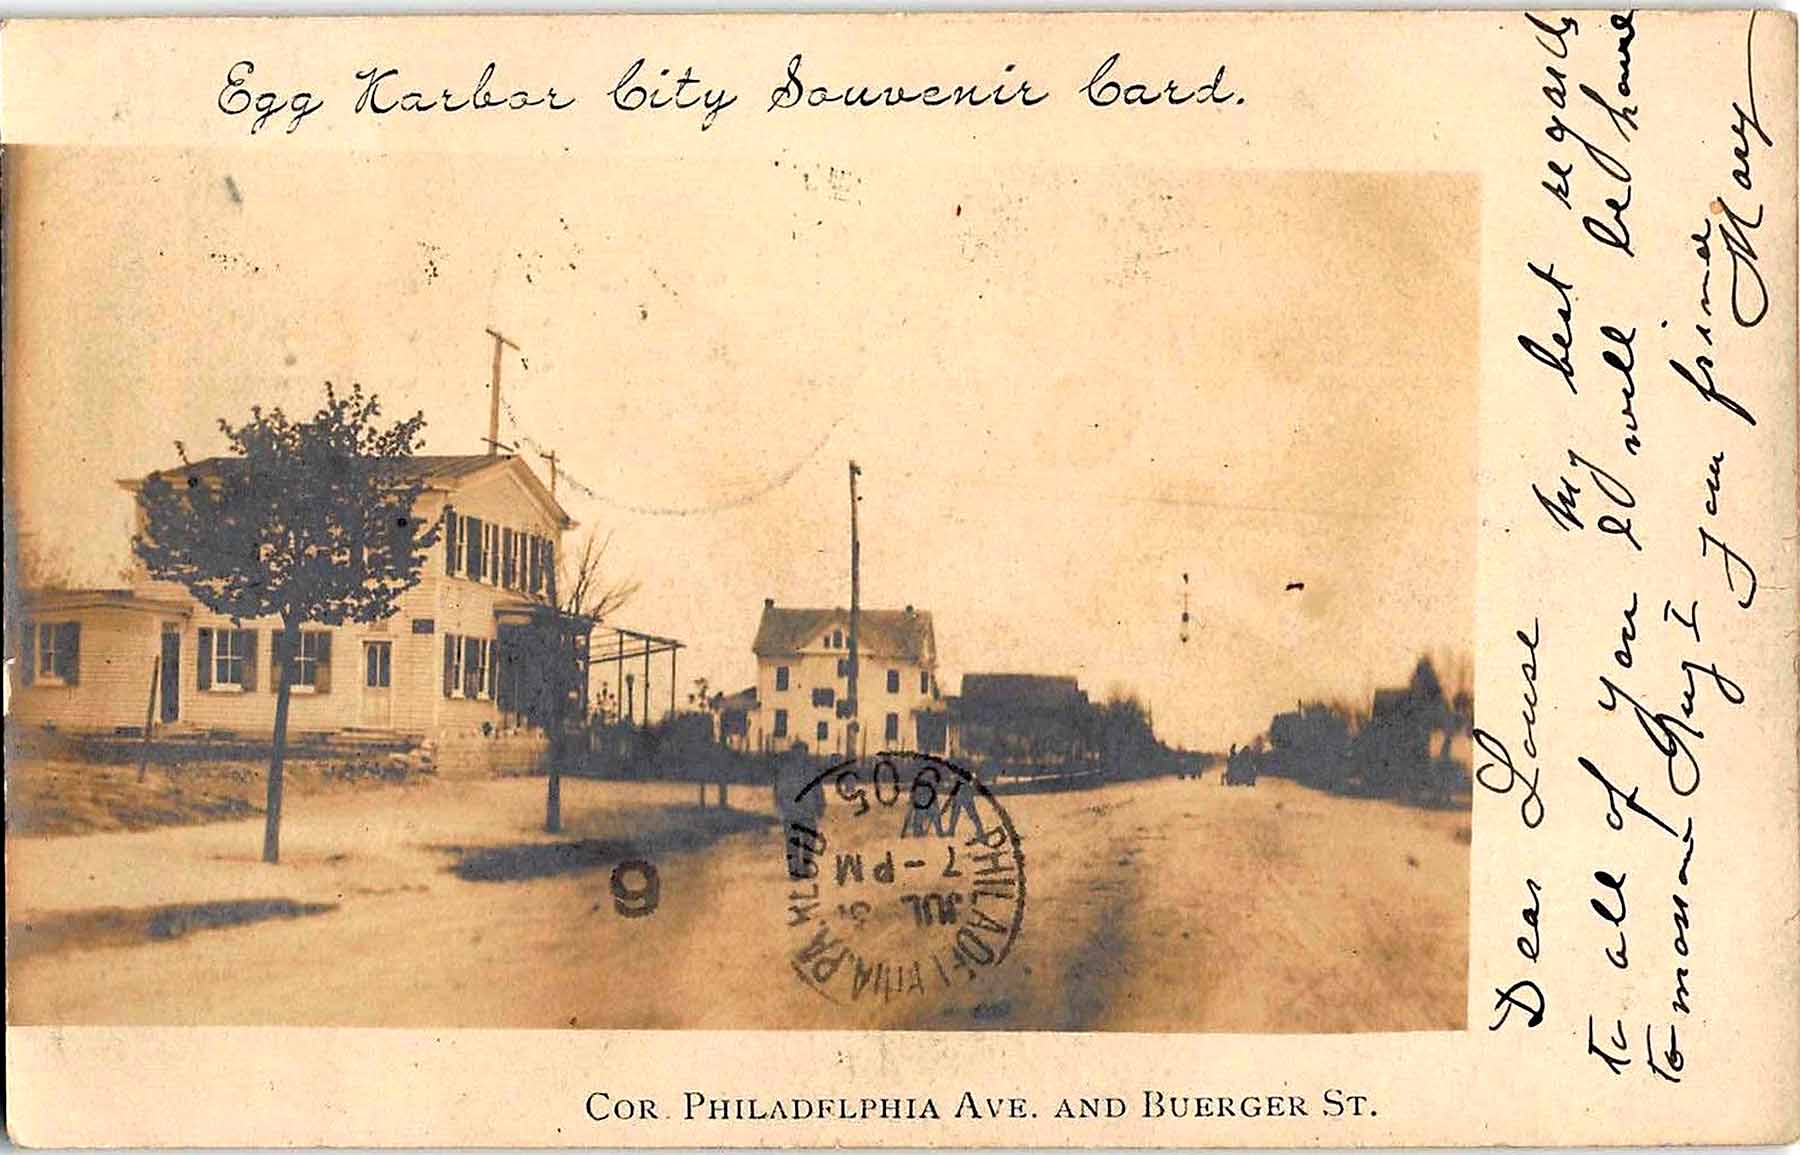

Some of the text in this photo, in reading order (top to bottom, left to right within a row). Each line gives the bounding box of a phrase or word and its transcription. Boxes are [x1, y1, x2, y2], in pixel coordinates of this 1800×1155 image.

[218, 53, 1244, 134] Egg Harbor City Souvenir Card.
[1715, 8, 1773, 328] Mary
[1582, 183, 1635, 258] be
[1517, 262, 1578, 395] best
[1600, 325, 1640, 457] will
[1577, 756, 1678, 836] of
[1488, 878, 1545, 1032] Dear
[1589, 870, 1627, 970] all
[955, 1092, 1036, 1118] AVE.
[1055, 1099, 1125, 1118] AND
[1143, 1091, 1308, 1117] BUERGER
[1323, 1090, 1376, 1116] ST.
